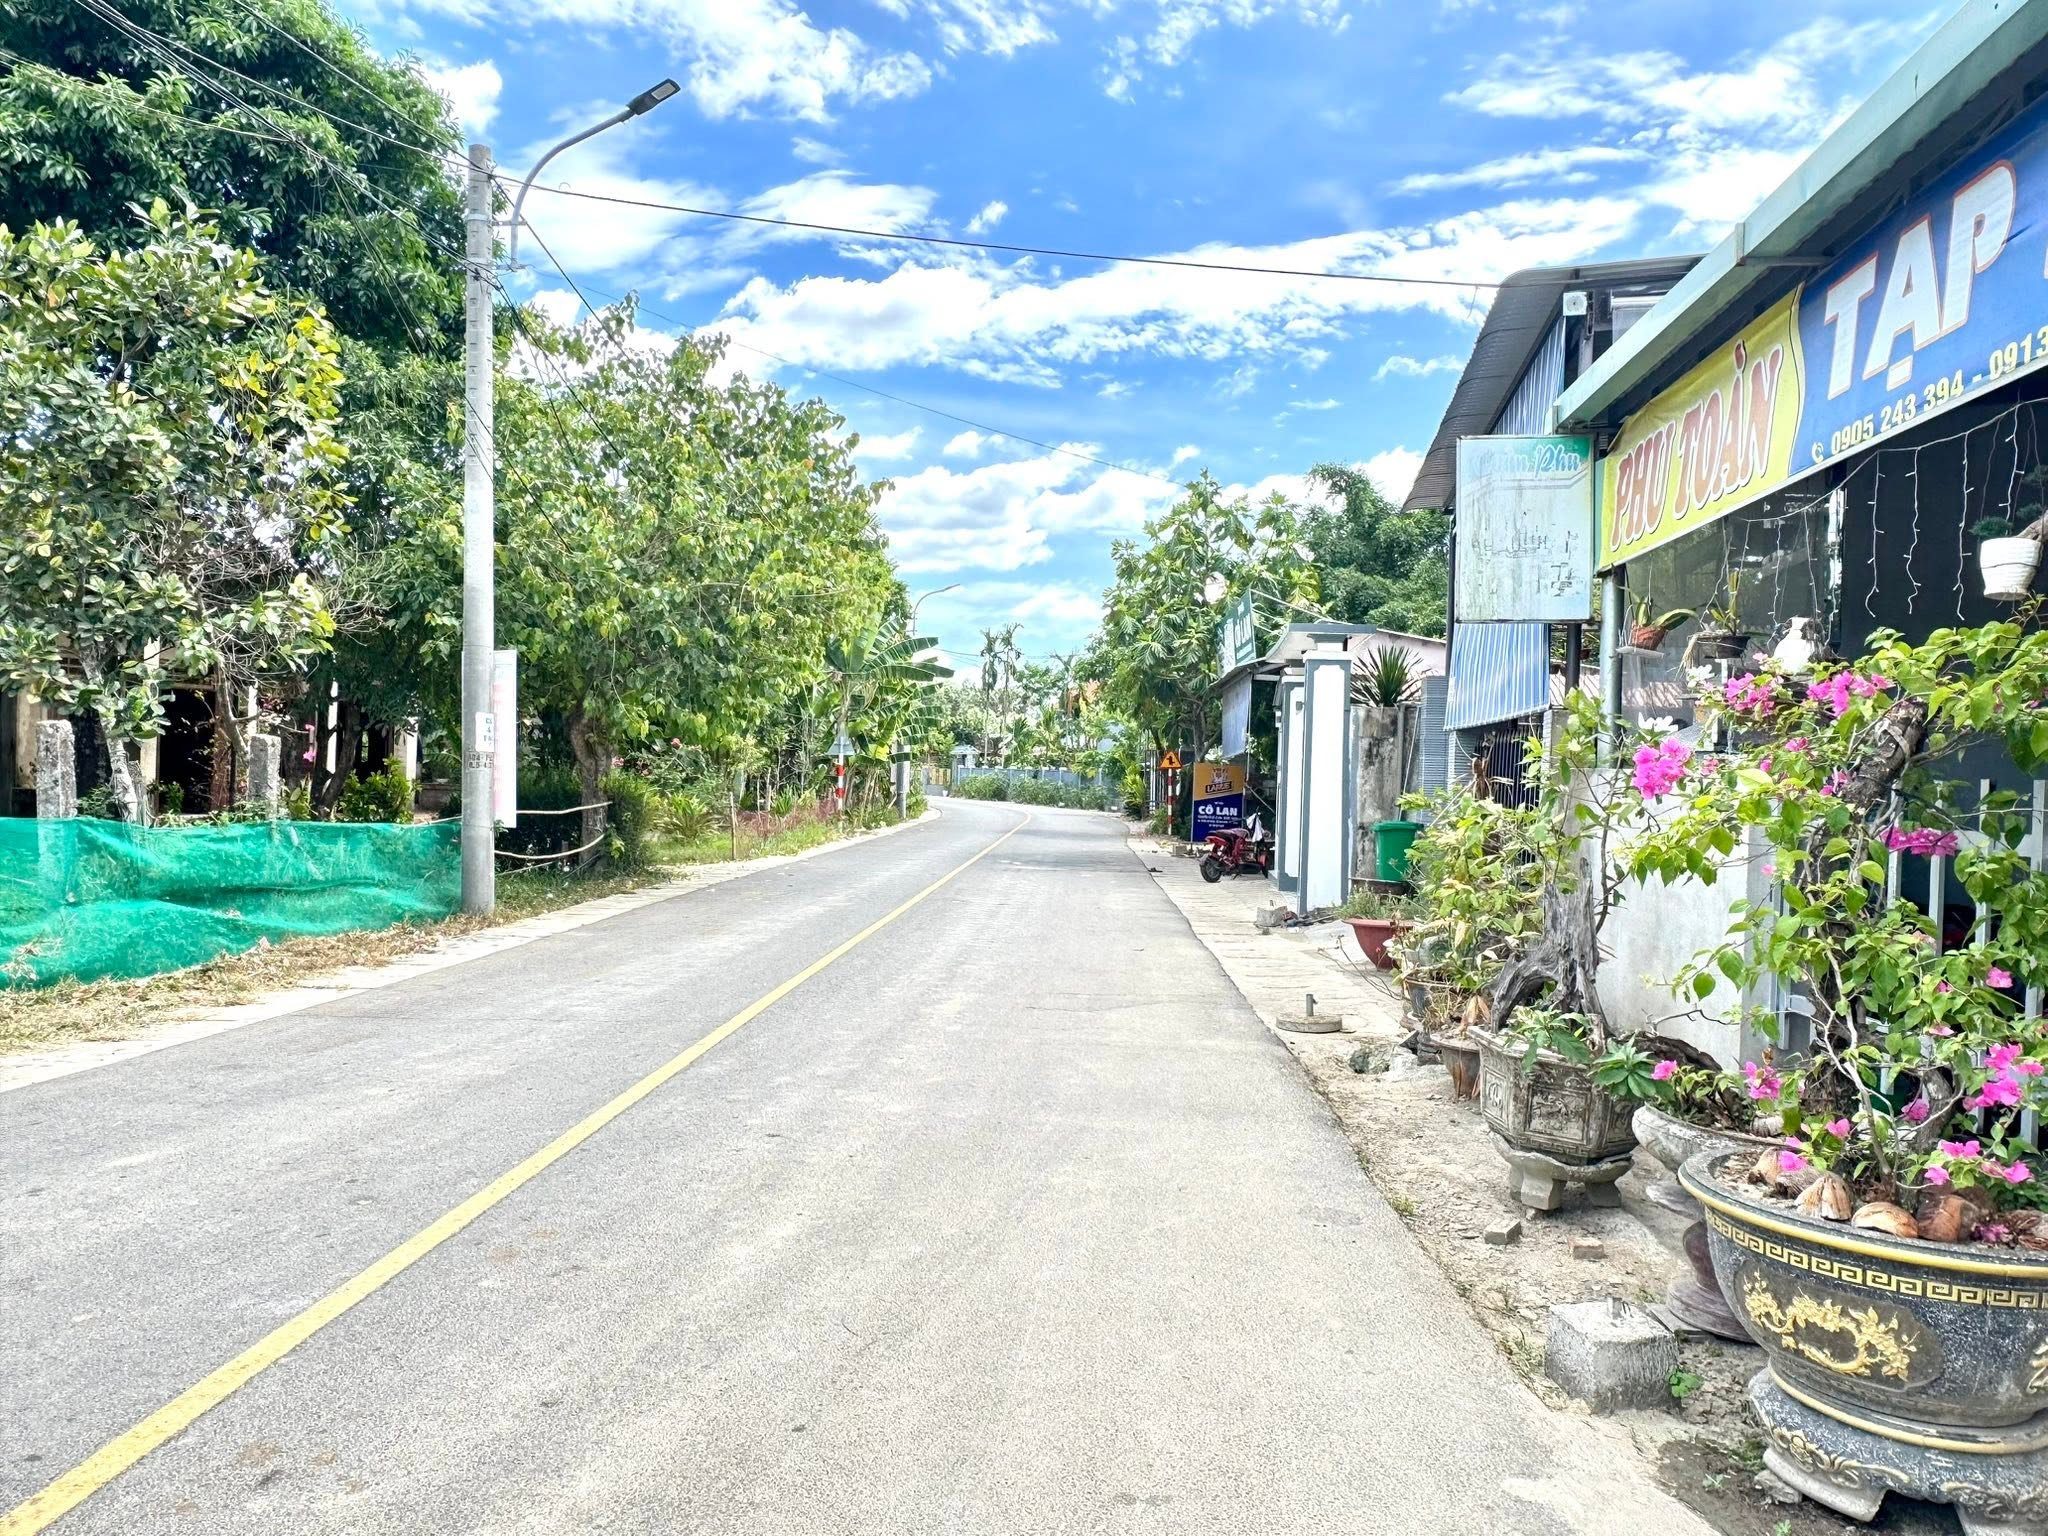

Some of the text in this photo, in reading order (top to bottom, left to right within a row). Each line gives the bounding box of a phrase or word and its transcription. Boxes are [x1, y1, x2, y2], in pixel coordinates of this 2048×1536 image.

[1824, 160, 2016, 400] TẠP
[1831, 413, 1874, 455] 0905
[1880, 393, 1916, 433] 243
[1923, 369, 1965, 412] 394
[1990, 325, 2048, 380] 0913
[1198, 804, 1238, 816] CÔ LAN
